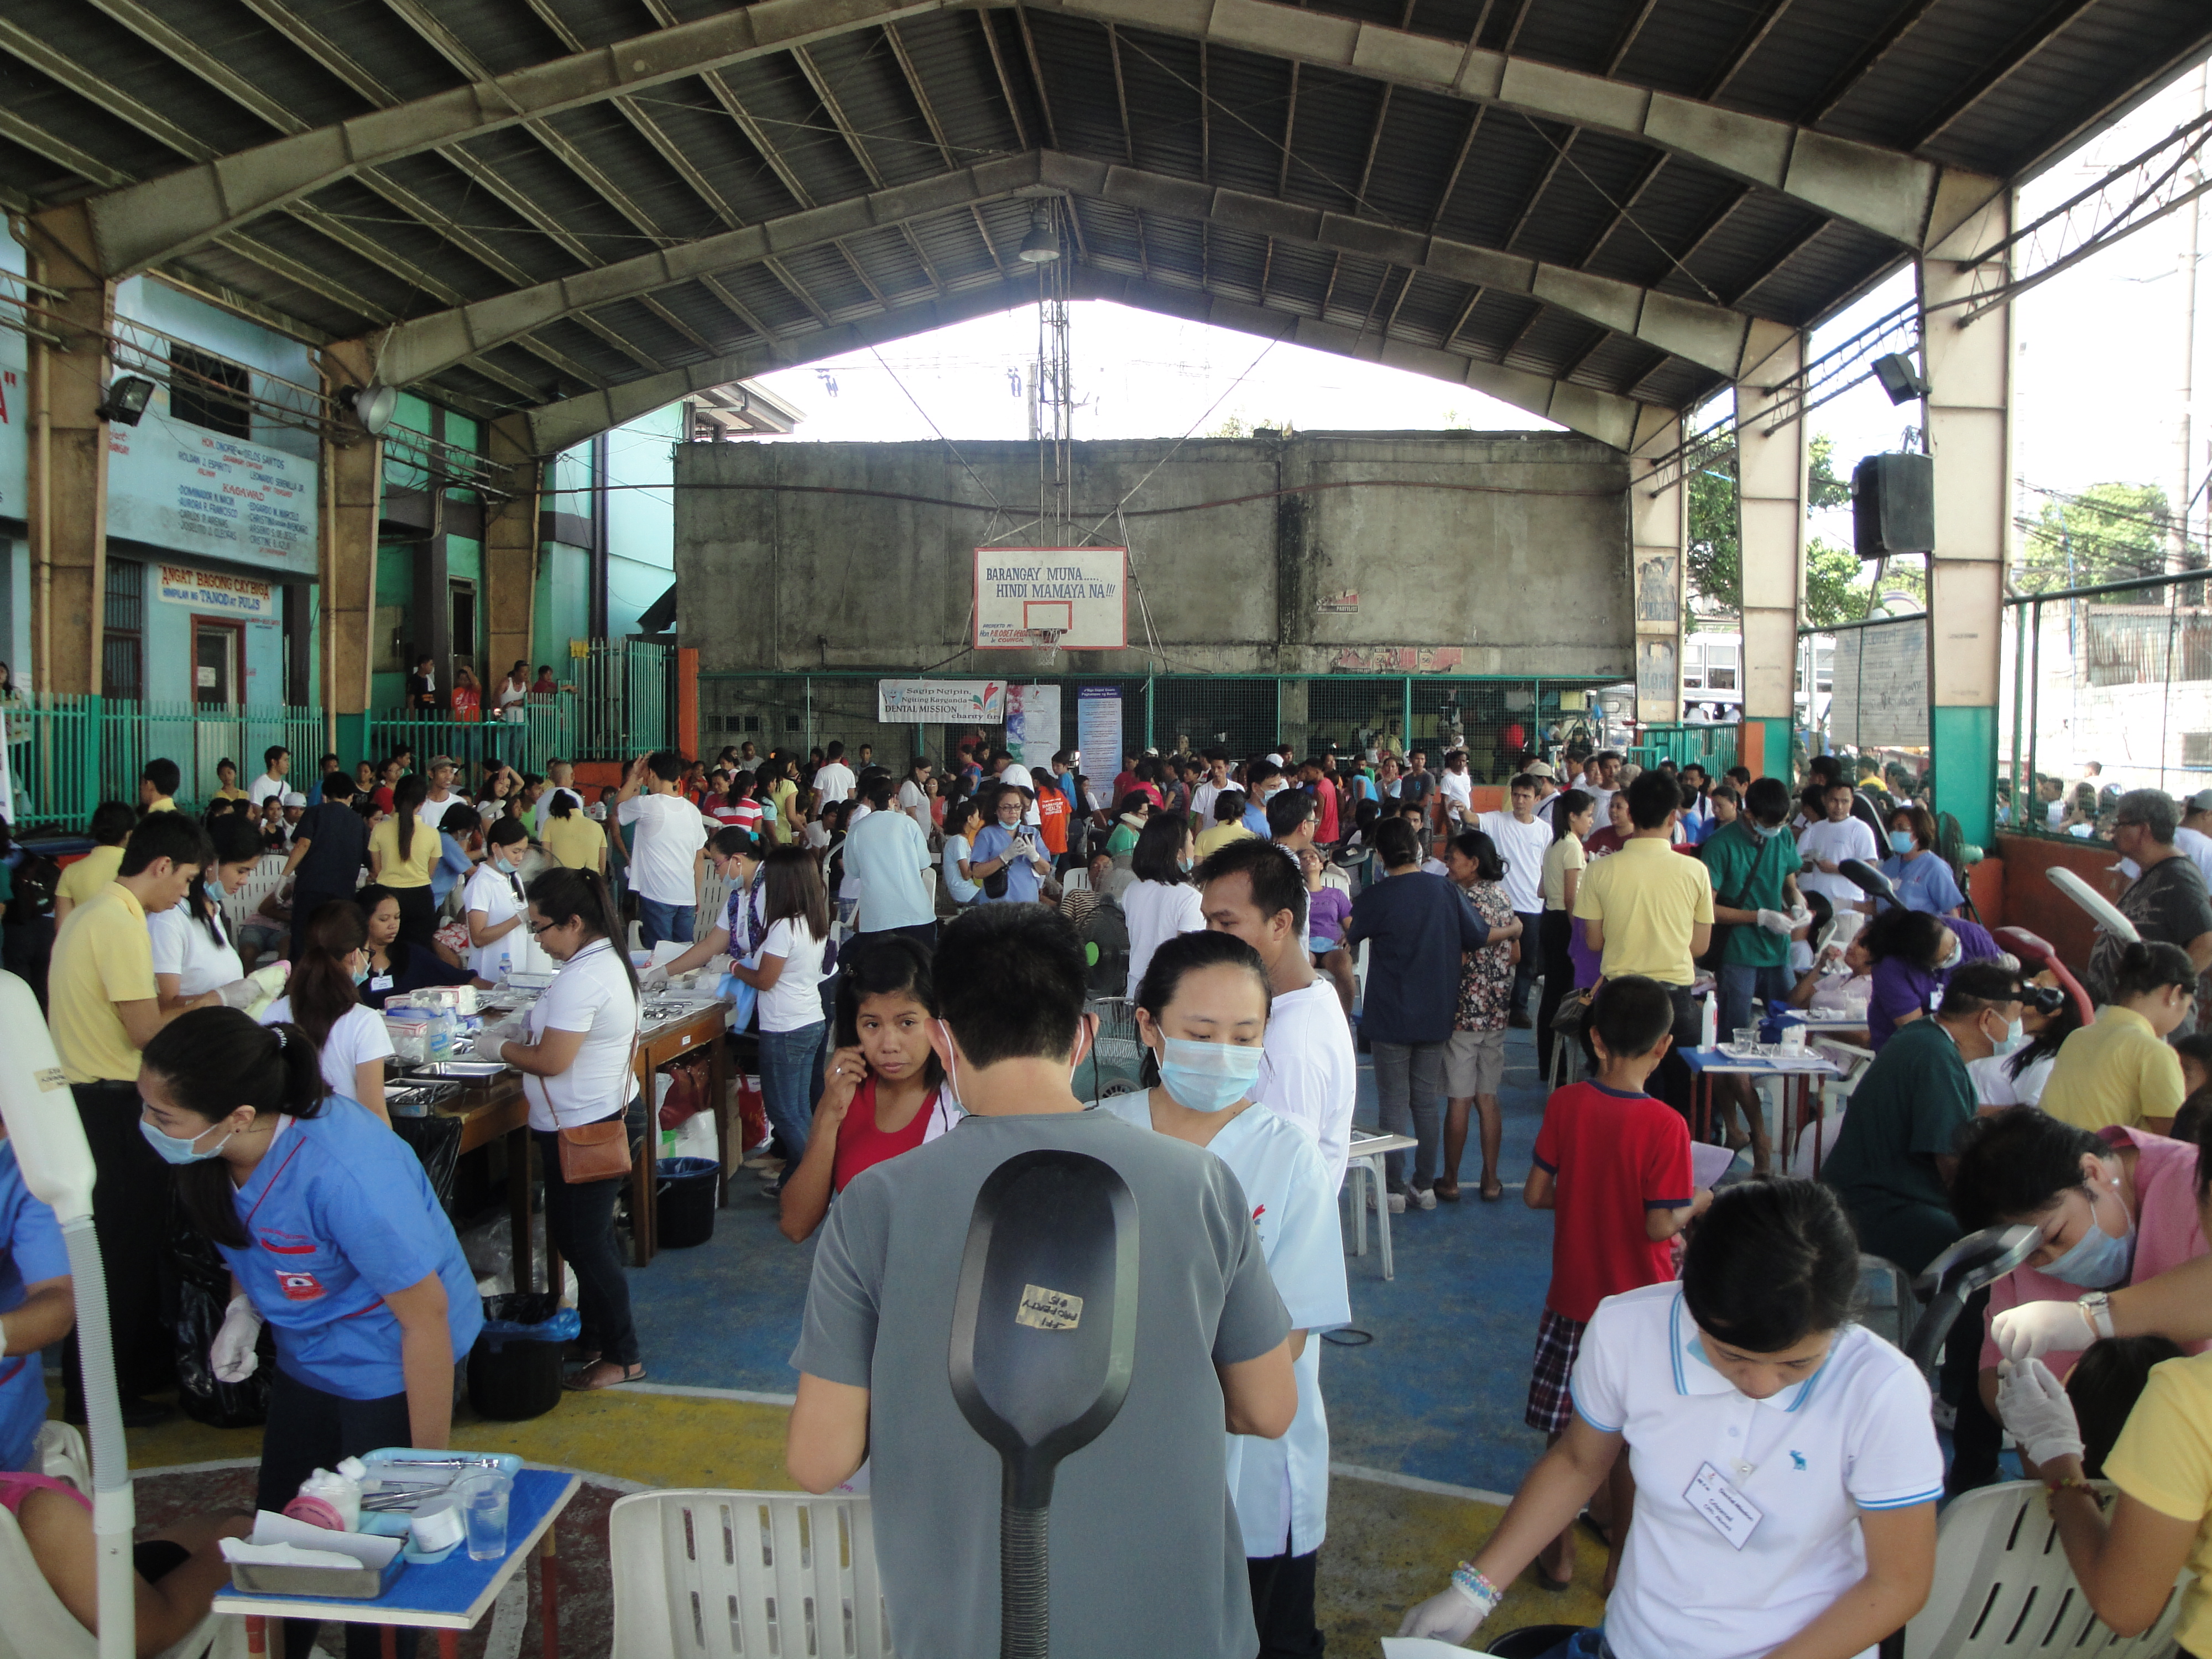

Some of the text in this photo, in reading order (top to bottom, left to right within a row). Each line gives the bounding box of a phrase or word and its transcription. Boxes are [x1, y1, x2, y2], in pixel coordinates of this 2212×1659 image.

[222, 483, 265, 501] KAGAWAD
[196, 572, 232, 590] BAGONG
[987, 567, 1042, 581] BARANGAY
[997, 583, 1116, 598] HINDI MAMAYA NA!!!
[199, 589, 229, 606] TANOD
[238, 596, 260, 611] PULIS
[906, 688, 935, 697] Sagip
[1022, 1299, 1078, 1321] PROPERTY
